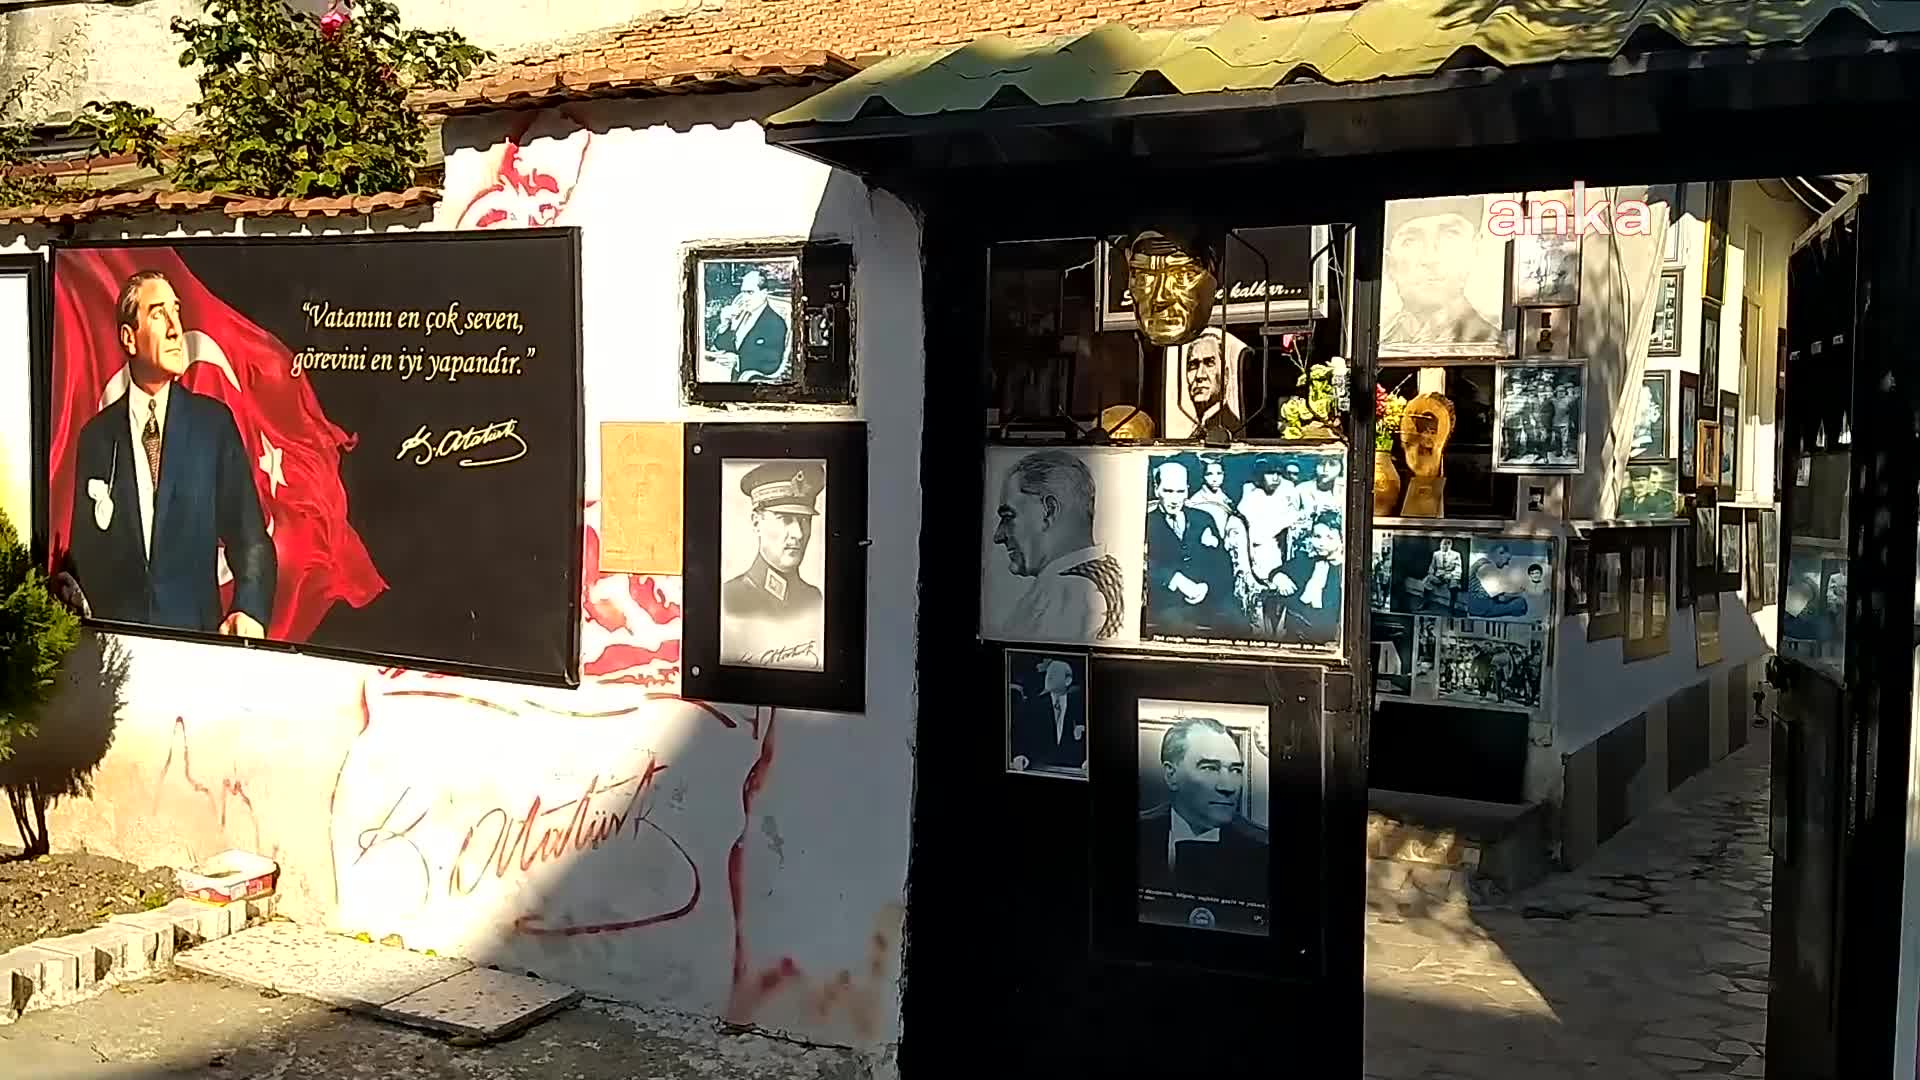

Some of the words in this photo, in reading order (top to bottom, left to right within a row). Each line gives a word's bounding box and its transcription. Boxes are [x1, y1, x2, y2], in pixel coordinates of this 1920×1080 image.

[397, 311, 420, 329] en
[425, 301, 464, 336] çok
[464, 311, 524, 335] seven,
[290, 346, 367, 377] görevini
[370, 354, 393, 371] en
[399, 346, 425, 380] iyi
